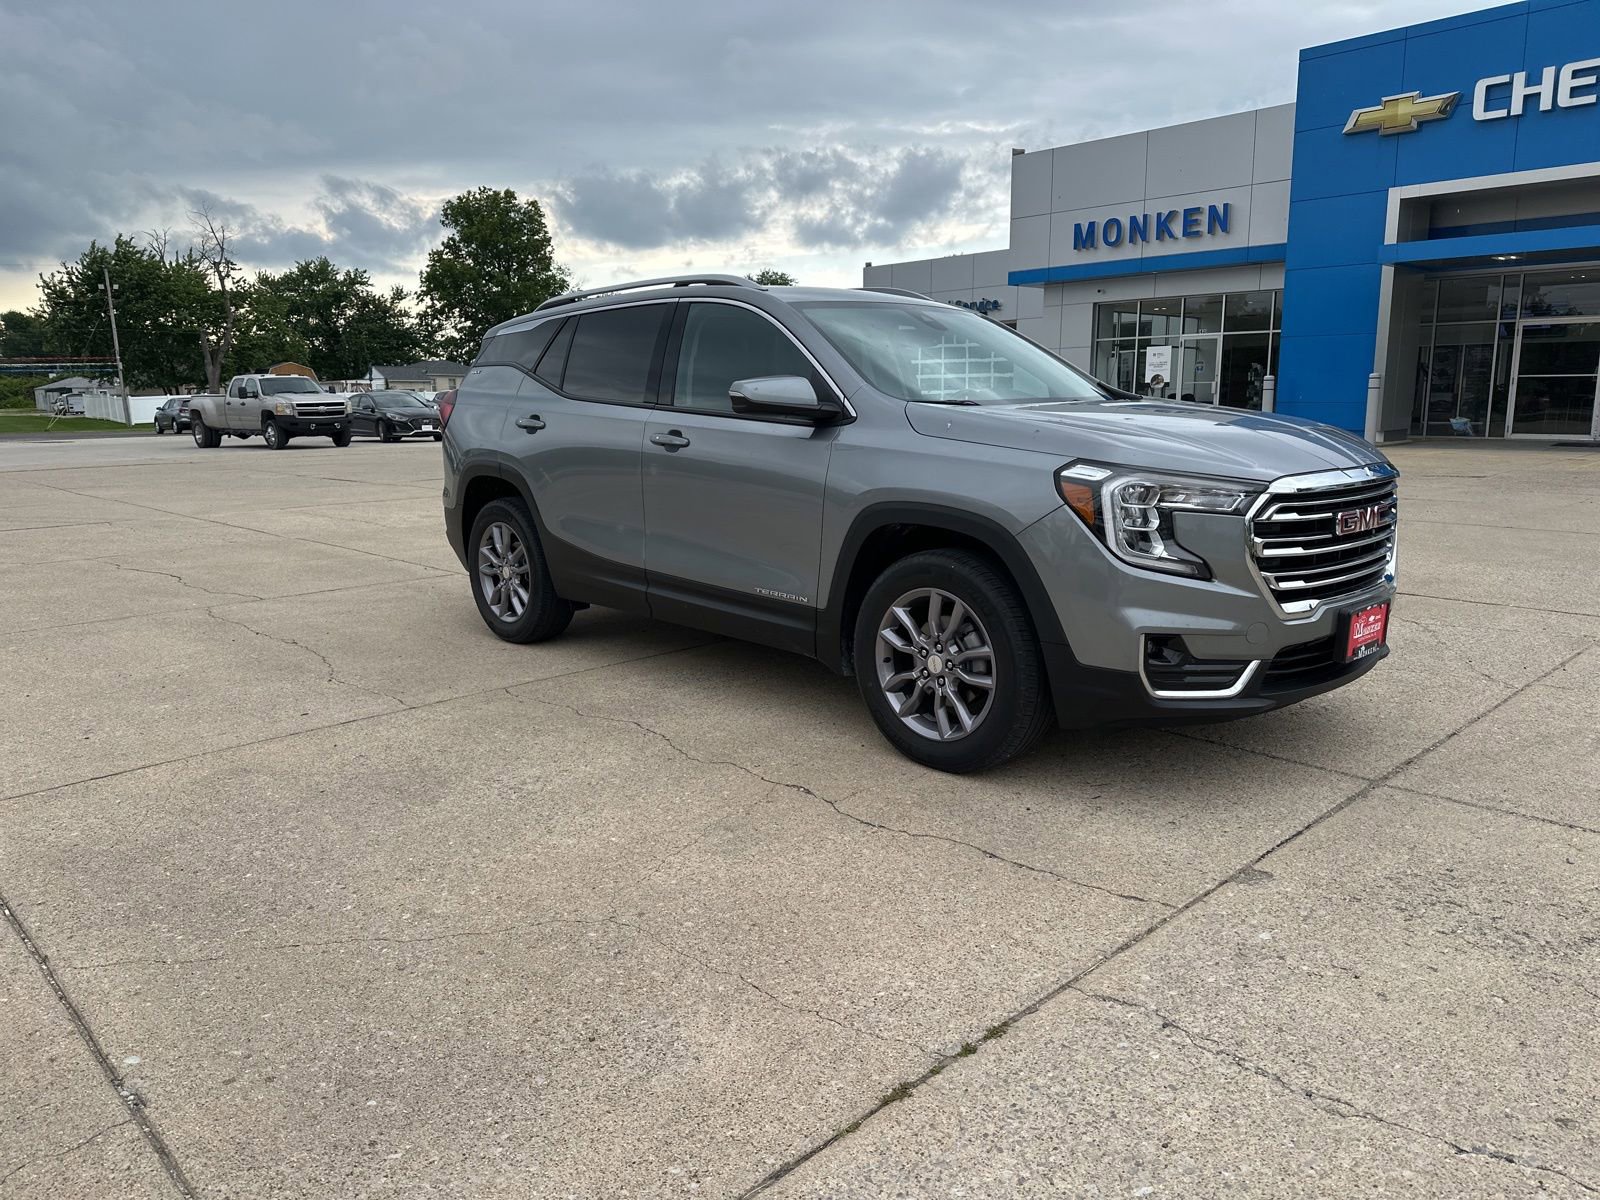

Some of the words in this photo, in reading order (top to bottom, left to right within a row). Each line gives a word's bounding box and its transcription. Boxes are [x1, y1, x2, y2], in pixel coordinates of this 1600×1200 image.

[1473, 57, 1600, 120] CHE
[1073, 202, 1231, 250] MONKEN
[1336, 505, 1391, 536] GMC
[754, 586, 808, 602] TERRAIN
